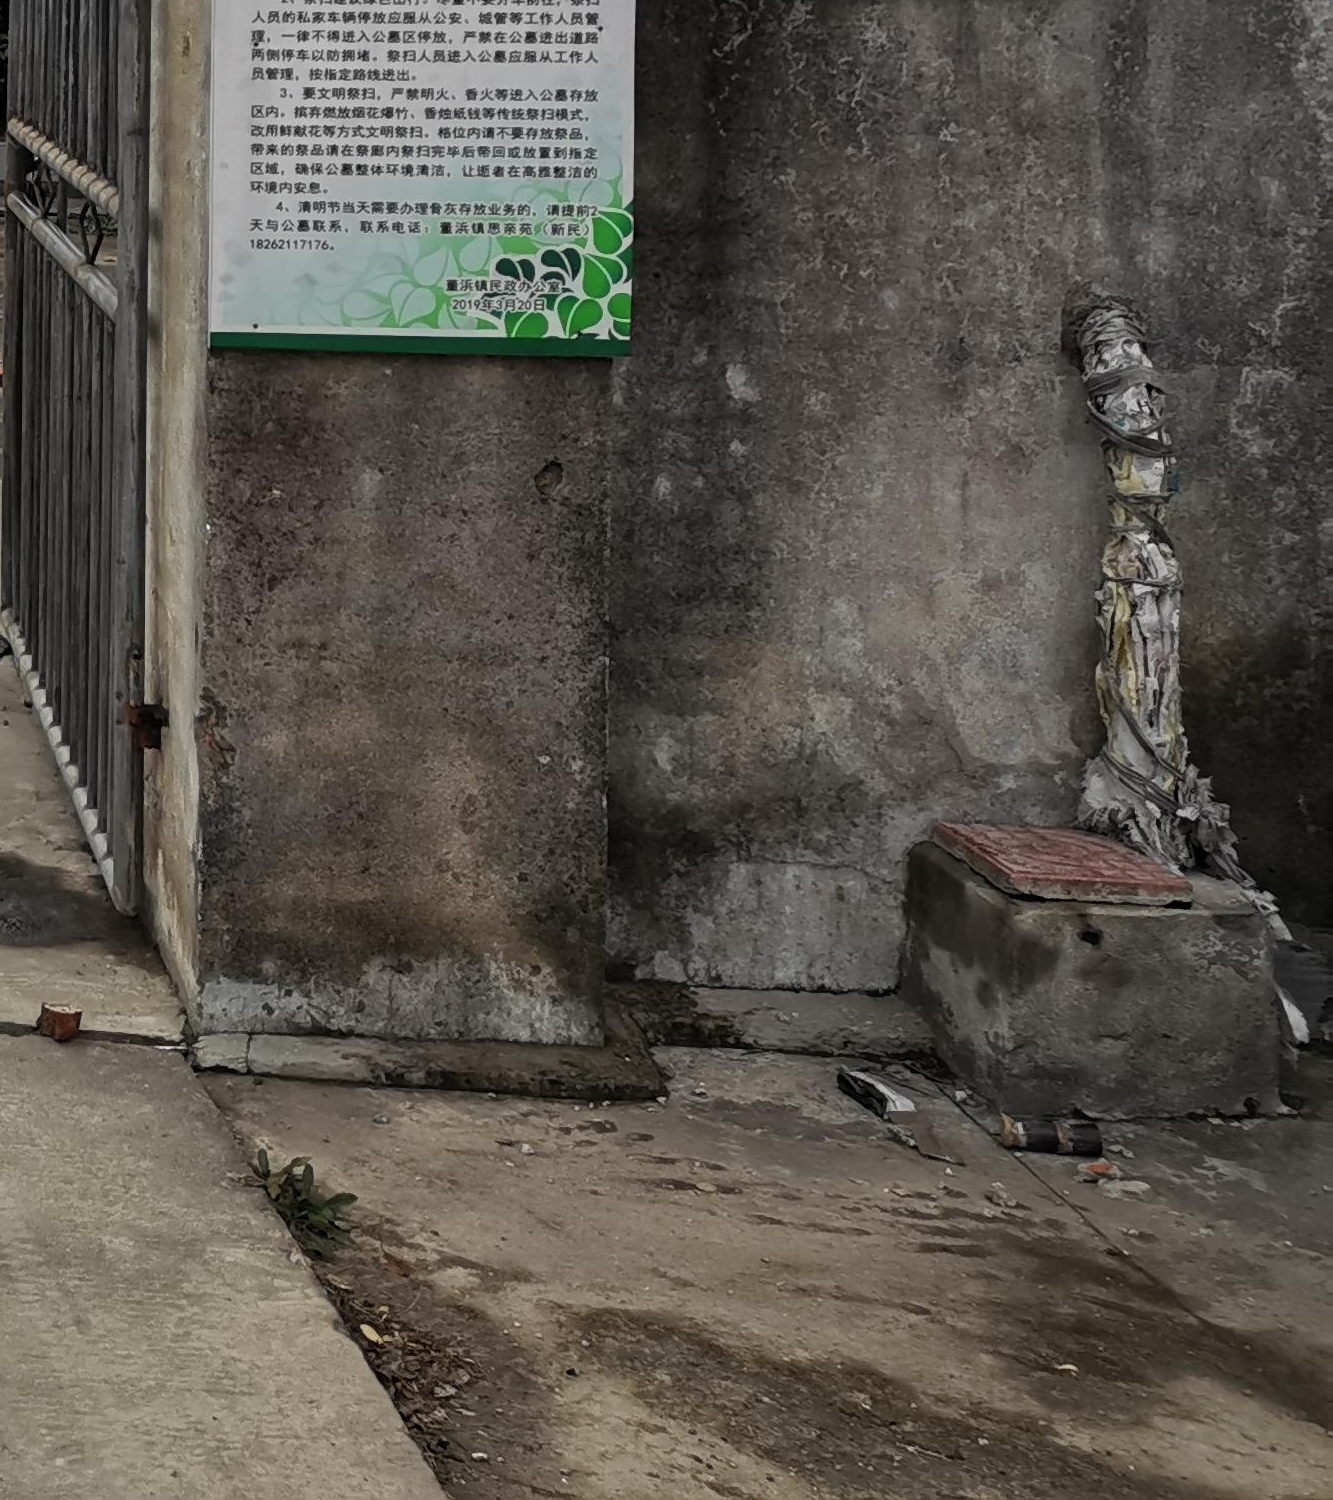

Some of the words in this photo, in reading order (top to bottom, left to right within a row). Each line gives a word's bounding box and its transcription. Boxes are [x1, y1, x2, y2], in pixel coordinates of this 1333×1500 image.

[250, 67, 417, 82] 员管理，按指定路线进出。
[249, 181, 329, 195] 环境内安息。
[445, 278, 561, 293] 董浜镇民政办公室
[452, 298, 545, 312] 2019年3月20日
